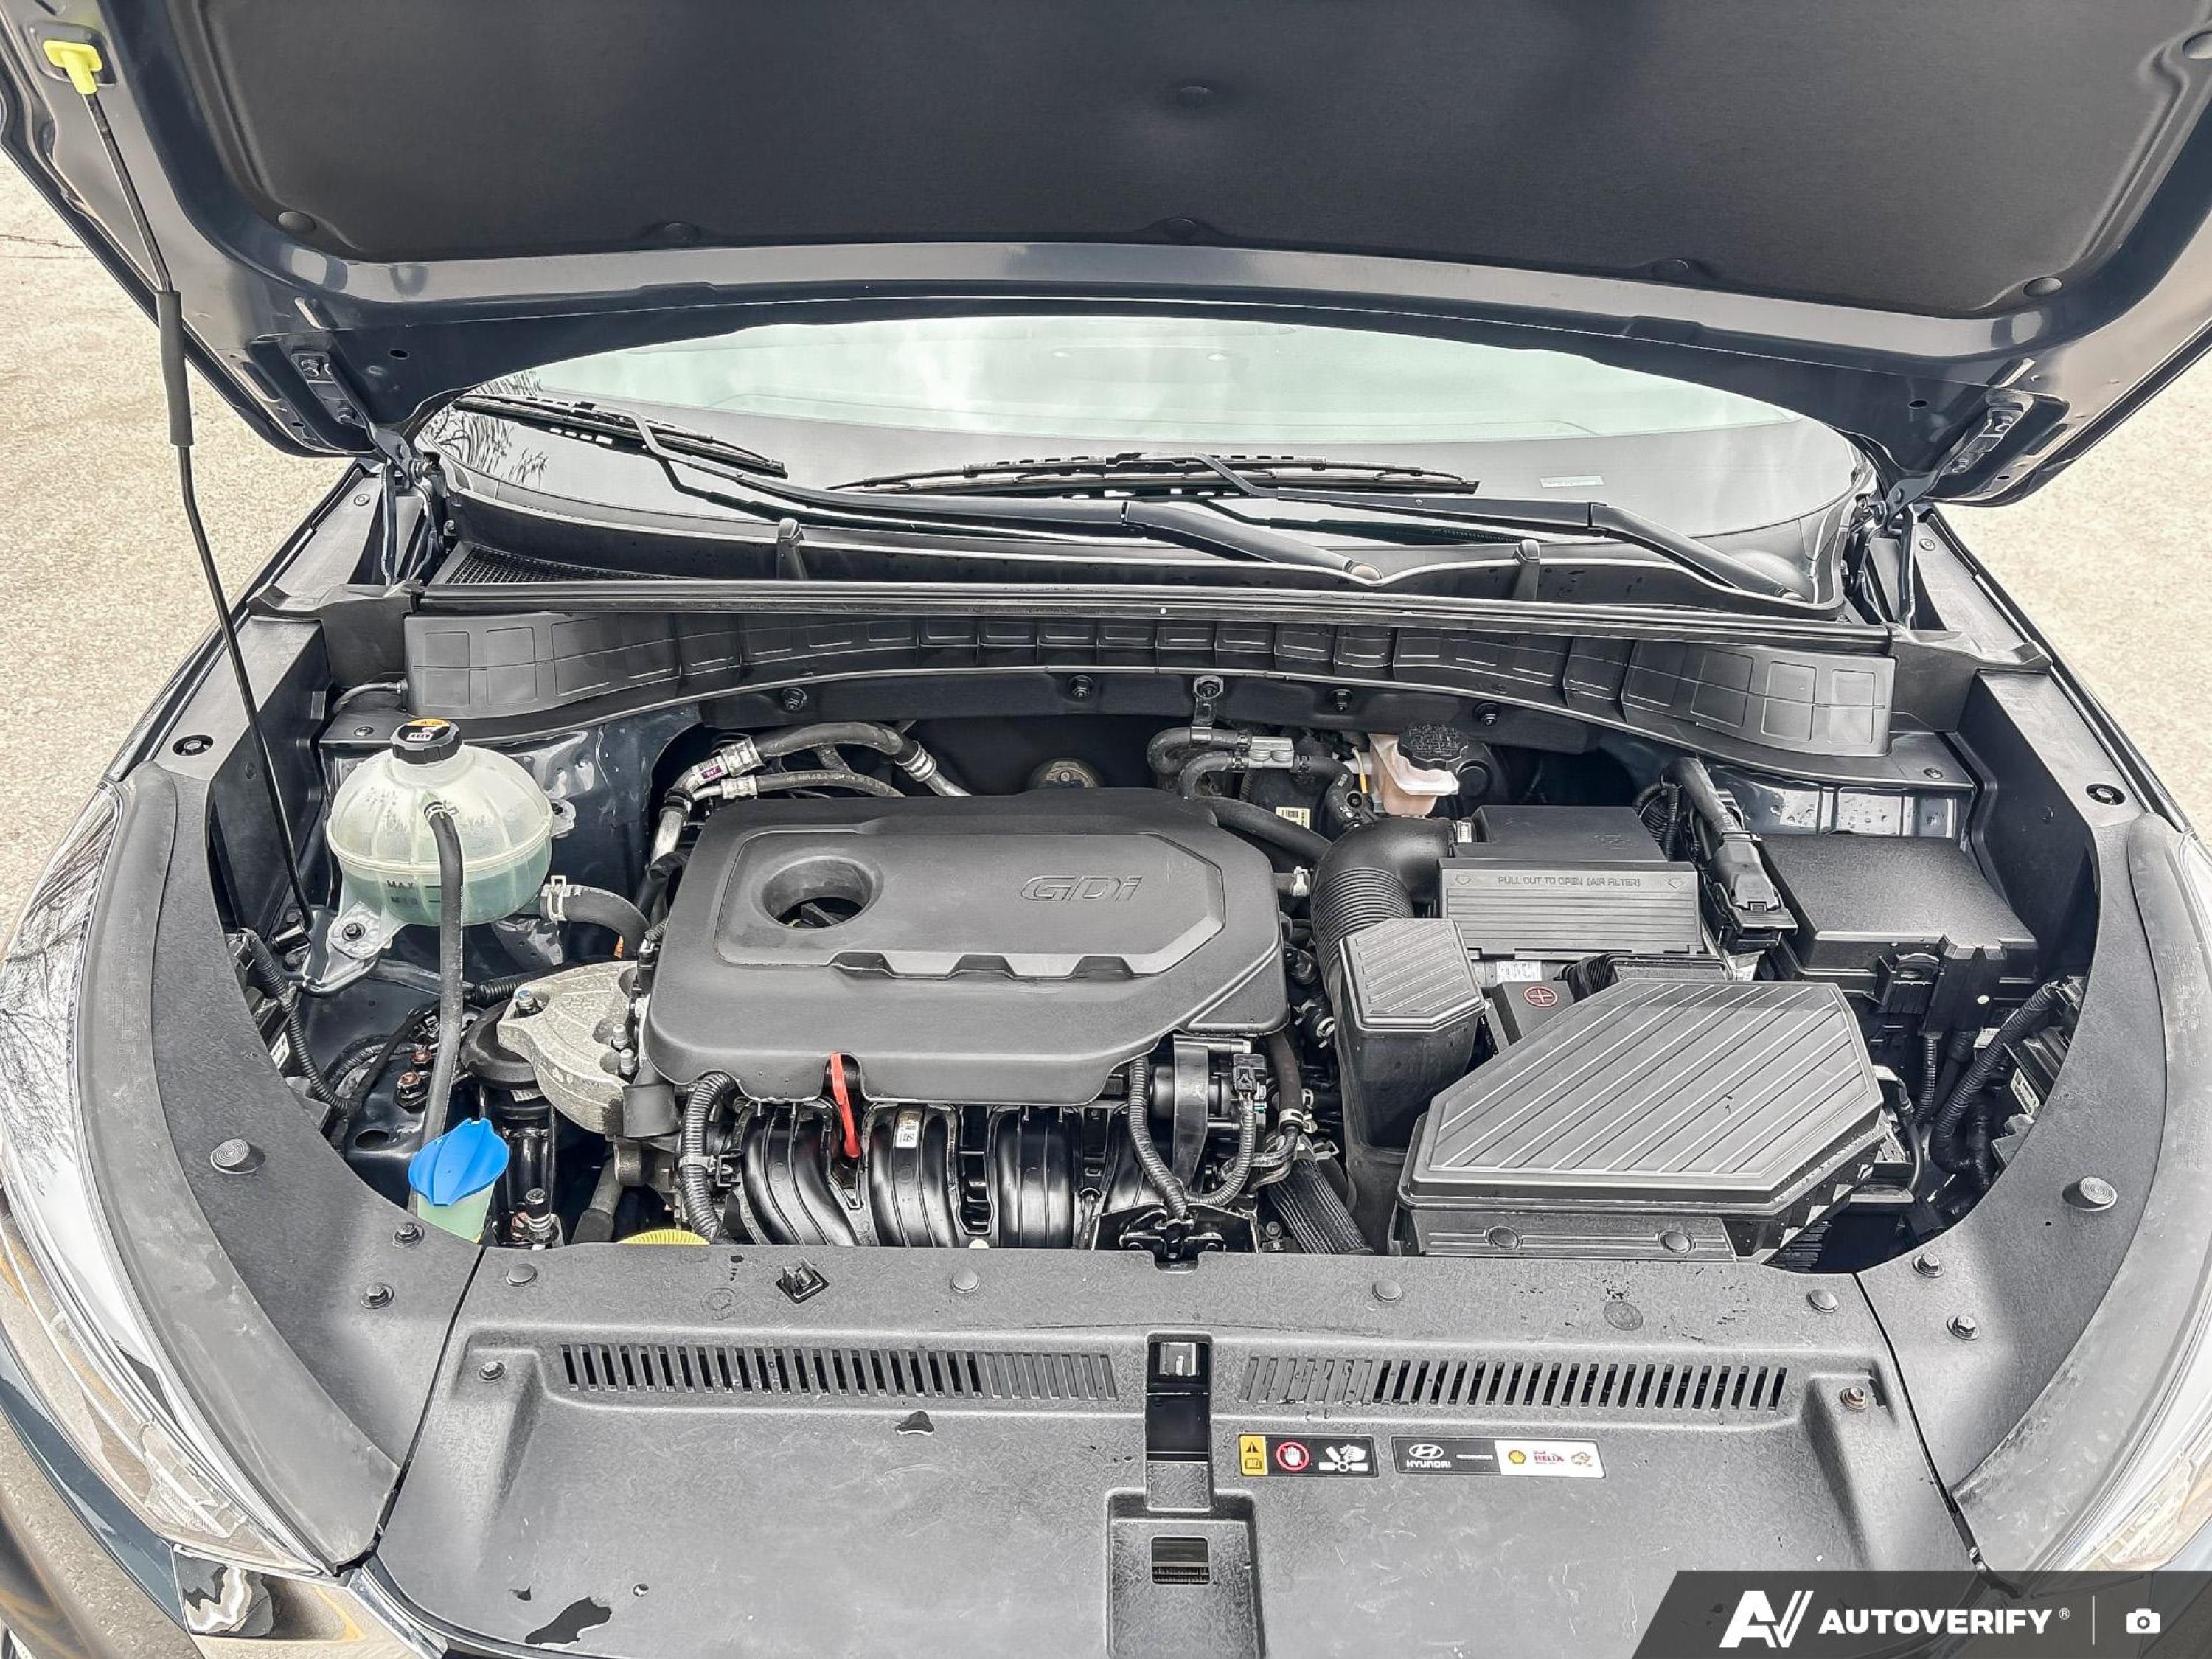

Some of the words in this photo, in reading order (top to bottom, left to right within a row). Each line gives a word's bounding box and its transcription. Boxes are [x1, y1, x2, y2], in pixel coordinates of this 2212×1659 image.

[386, 880, 414, 889] MAX
[1498, 876, 1522, 885] PULL
[1523, 876, 1542, 885] OUT
[1544, 876, 1556, 885] TO
[1558, 876, 1582, 886] OPEN
[1406, 1459, 1451, 1469] HYUNDAI
